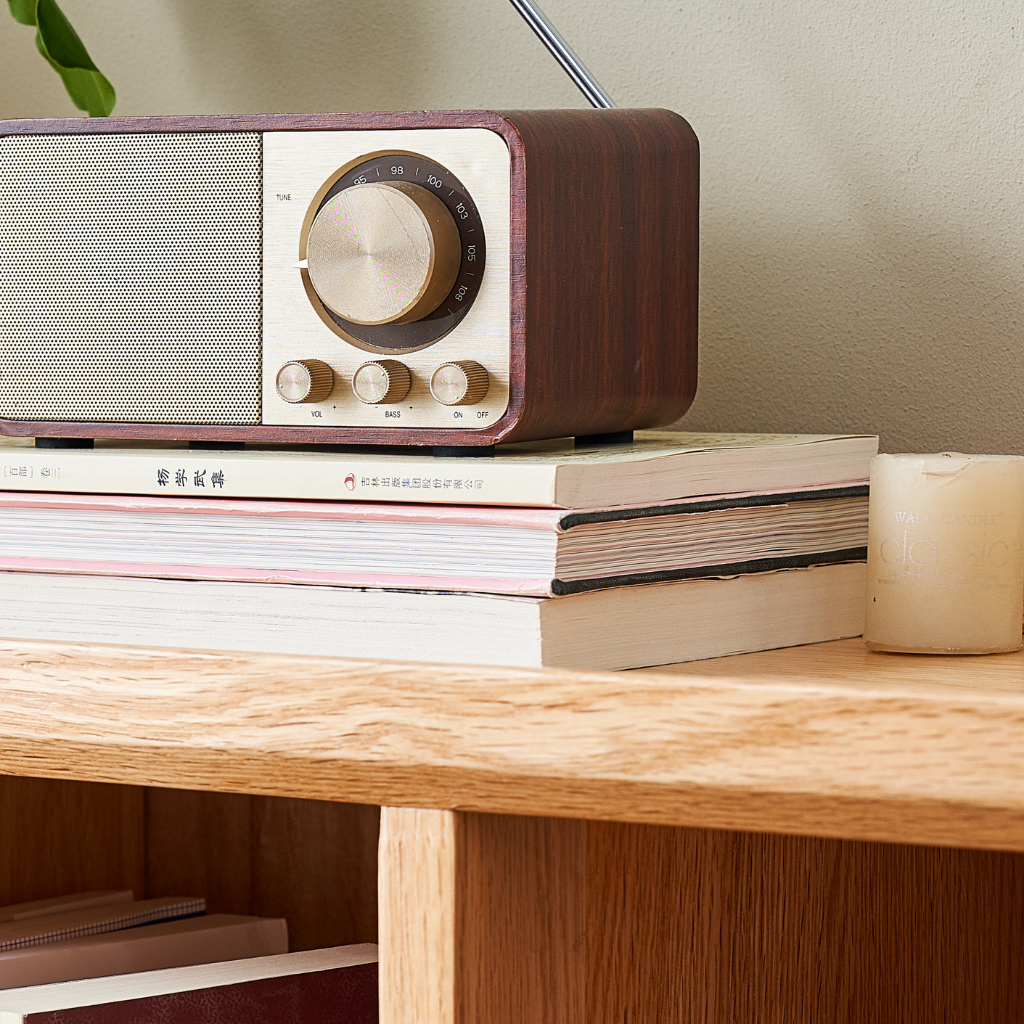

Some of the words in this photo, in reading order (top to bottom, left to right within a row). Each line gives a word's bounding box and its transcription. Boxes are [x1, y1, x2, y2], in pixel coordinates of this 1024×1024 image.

[390, 165, 404, 175] 98
[353, 175, 367, 185] 95
[426, 174, 443, 189] 100
[276, 193, 292, 201] TUNE
[455, 202, 469, 220] 103
[467, 244, 476, 262] 105
[454, 284, 468, 301] 108
[454, 411, 464, 419] ON
[477, 411, 489, 419] OFF
[157, 468, 226, 490] 杨学武集
[361, 476, 484, 489] 吉林出版集团股份有限公司
